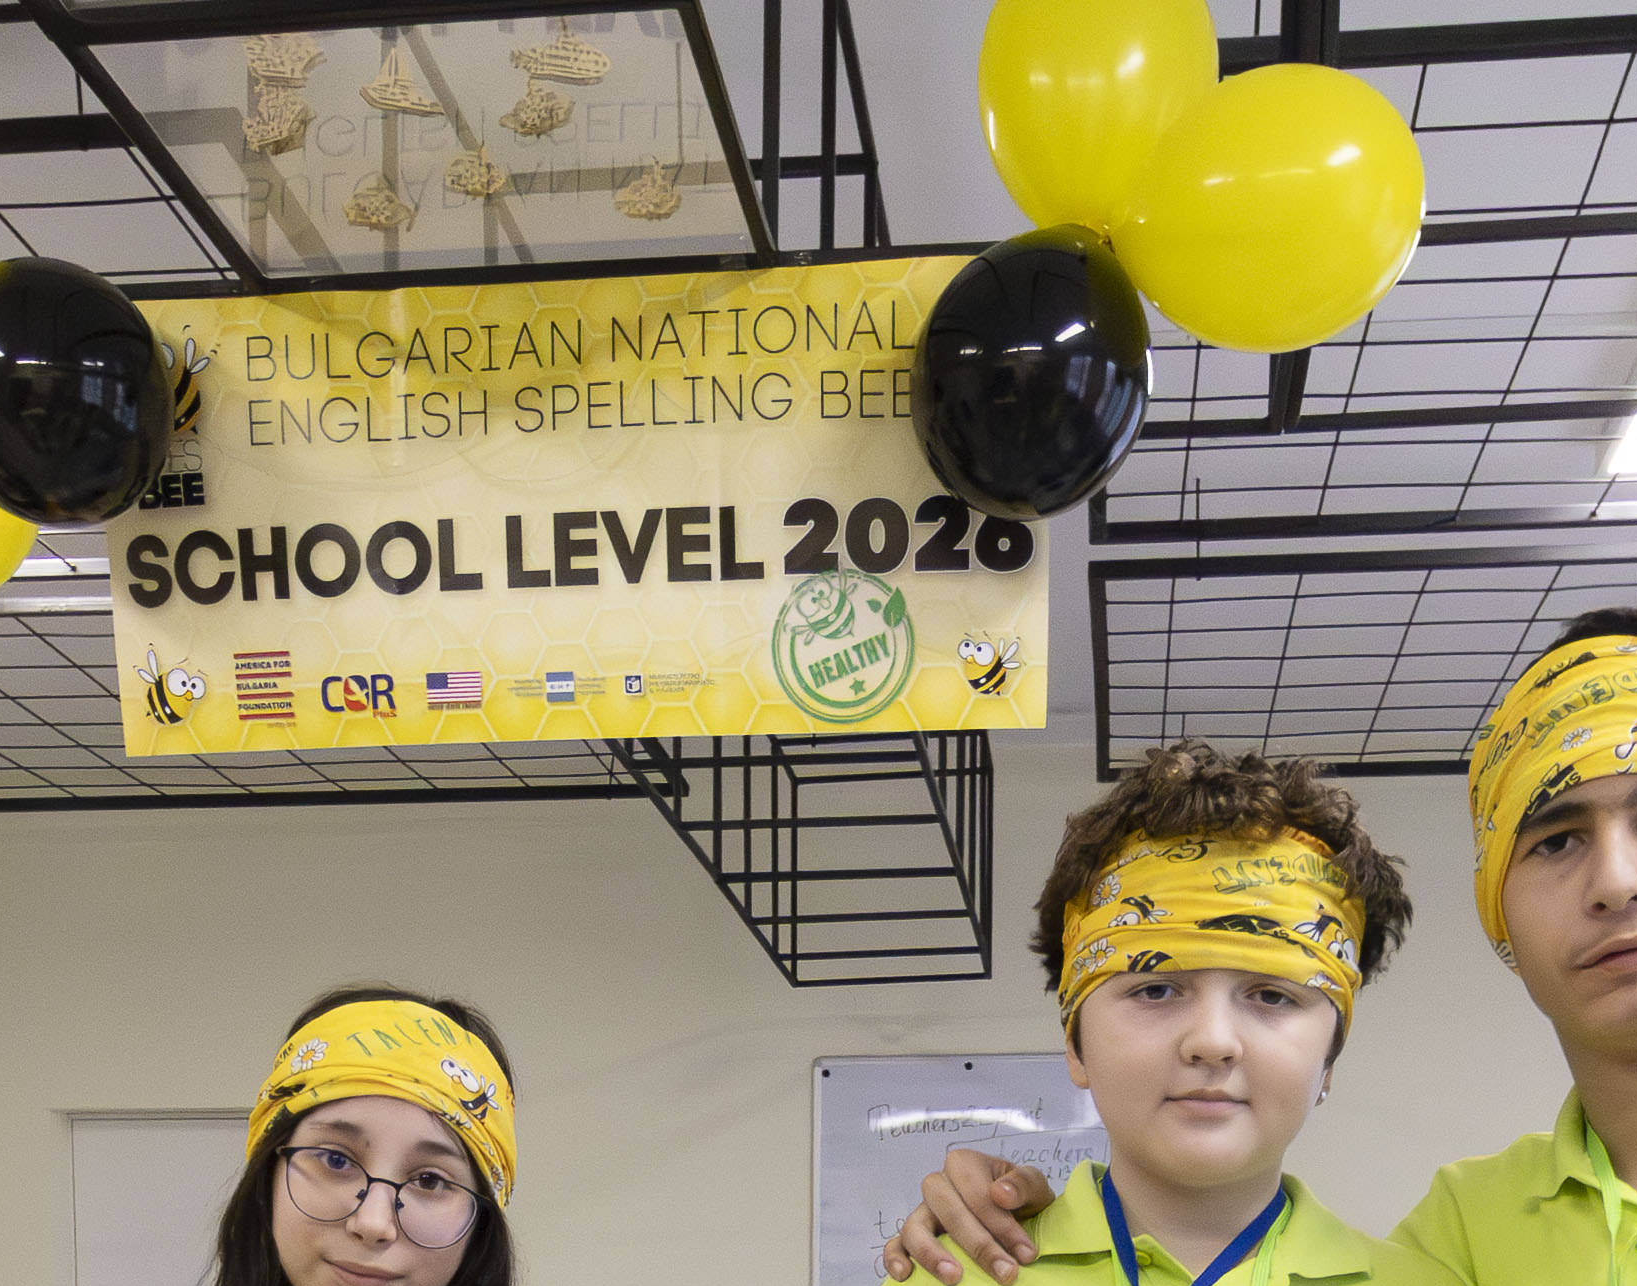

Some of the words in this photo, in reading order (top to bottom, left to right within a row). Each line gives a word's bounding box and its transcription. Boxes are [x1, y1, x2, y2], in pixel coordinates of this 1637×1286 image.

[246, 319, 584, 383] BULGARIAN
[610, 301, 914, 362] NATIONAL
[248, 384, 489, 446] ENGLISH
[514, 371, 792, 434] SPELLING
[820, 368, 912, 422] BEE
[139, 473, 205, 509] BEE
[126, 518, 483, 608] SCHOOL
[507, 505, 764, 591] LEVEL
[782, 496, 1035, 576] 2026
[234, 661, 272, 672] AMERICA
[808, 636, 890, 687] HEALTHY
[237, 681, 278, 691] BULGARIA
[238, 701, 292, 712] FOUNDATION
